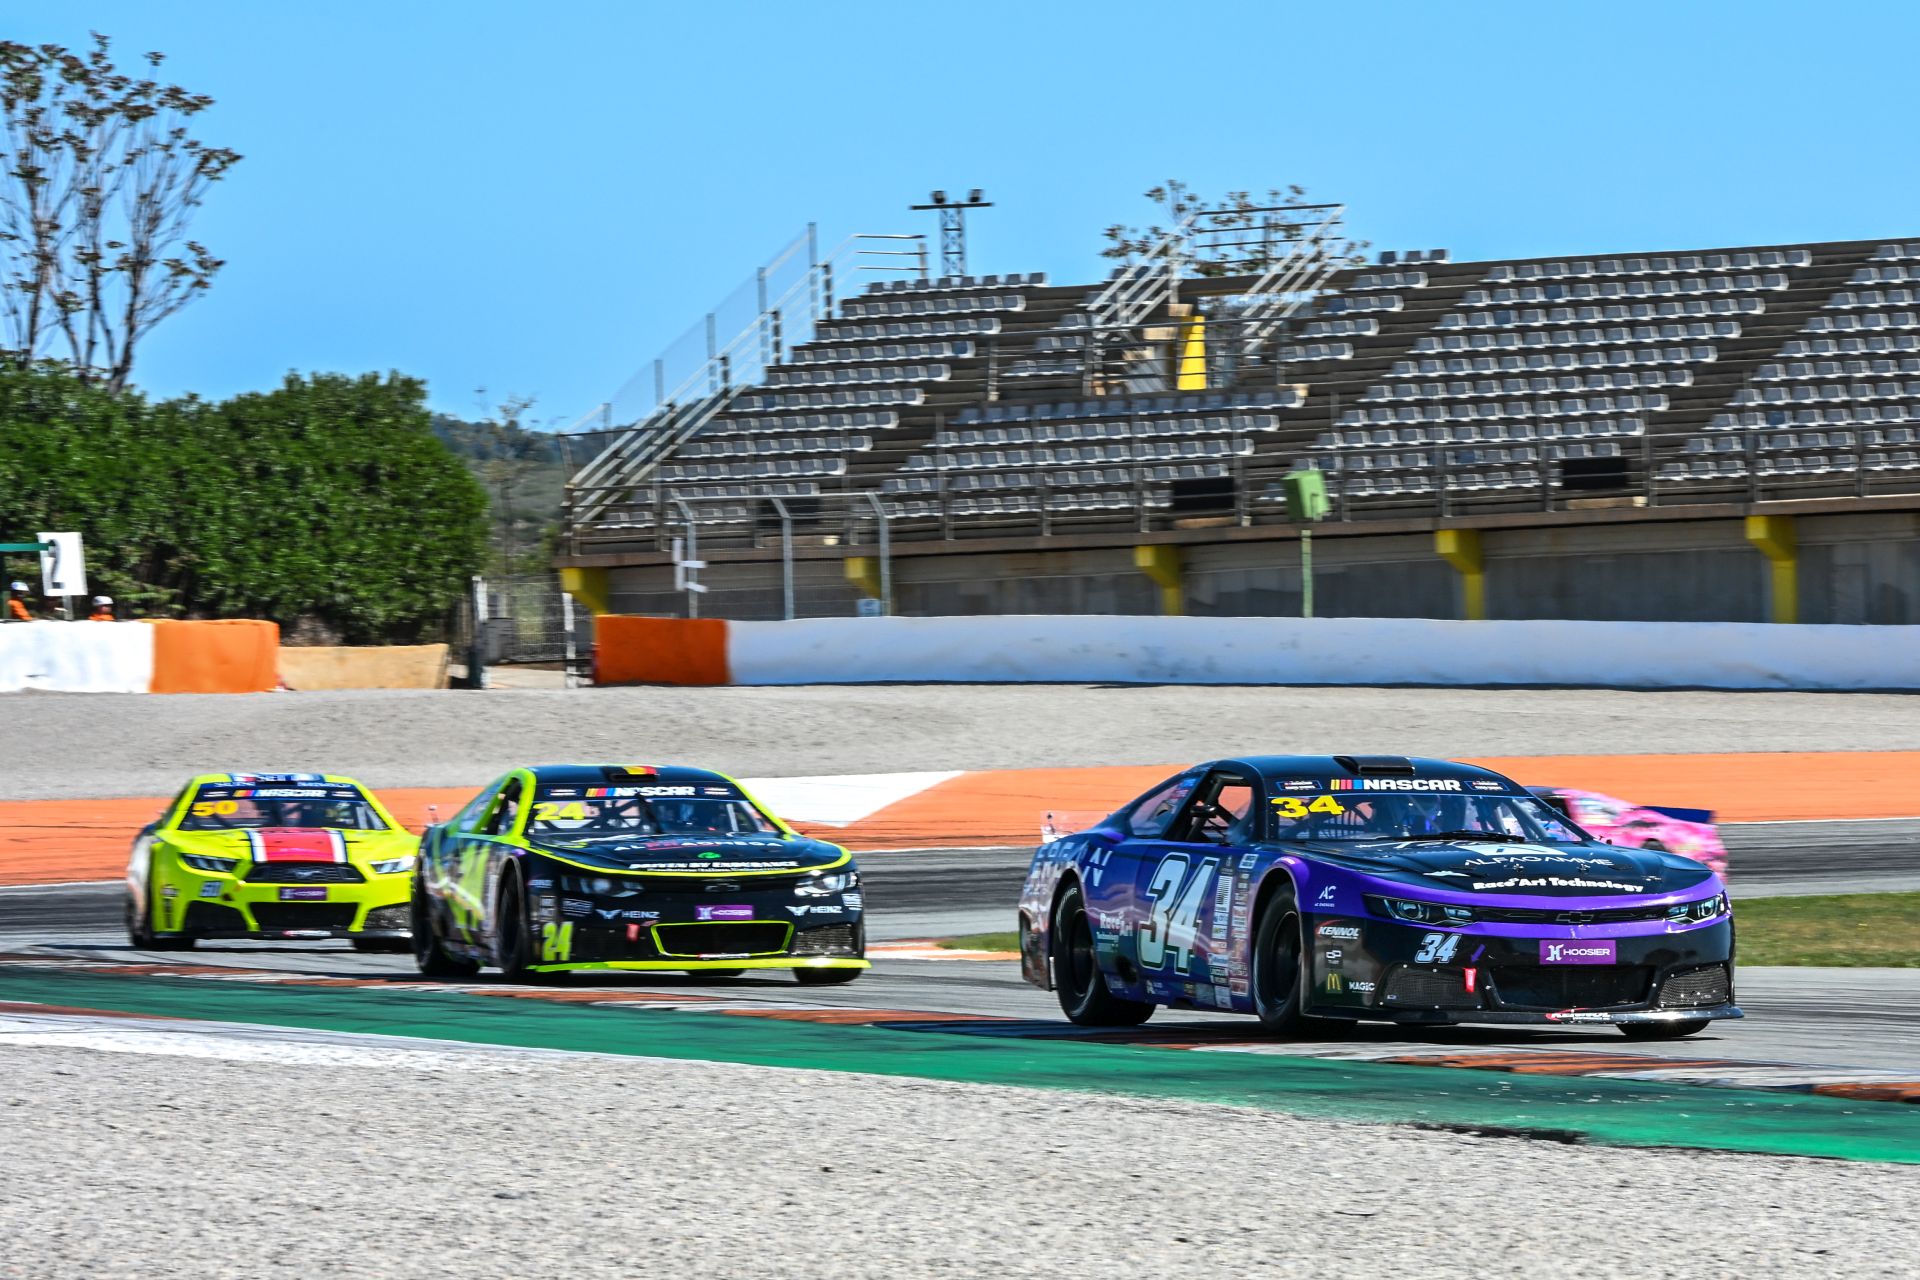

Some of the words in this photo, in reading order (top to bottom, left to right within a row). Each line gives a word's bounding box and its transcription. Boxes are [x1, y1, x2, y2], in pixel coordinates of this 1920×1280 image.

[1364, 779, 1462, 791] NASCAR
[192, 801, 239, 817] 50
[533, 801, 586, 821] 24
[1271, 795, 1345, 818] 34
[1548, 877, 1644, 893] Technology
[621, 910, 661, 919] HEINZ
[810, 905, 843, 914] HEINZ
[1138, 852, 1220, 977] 34
[1317, 926, 1361, 937] KENNOL
[542, 920, 574, 961] 24
[1415, 933, 1462, 964] 34
[1563, 948, 1611, 956] HOOSIER
